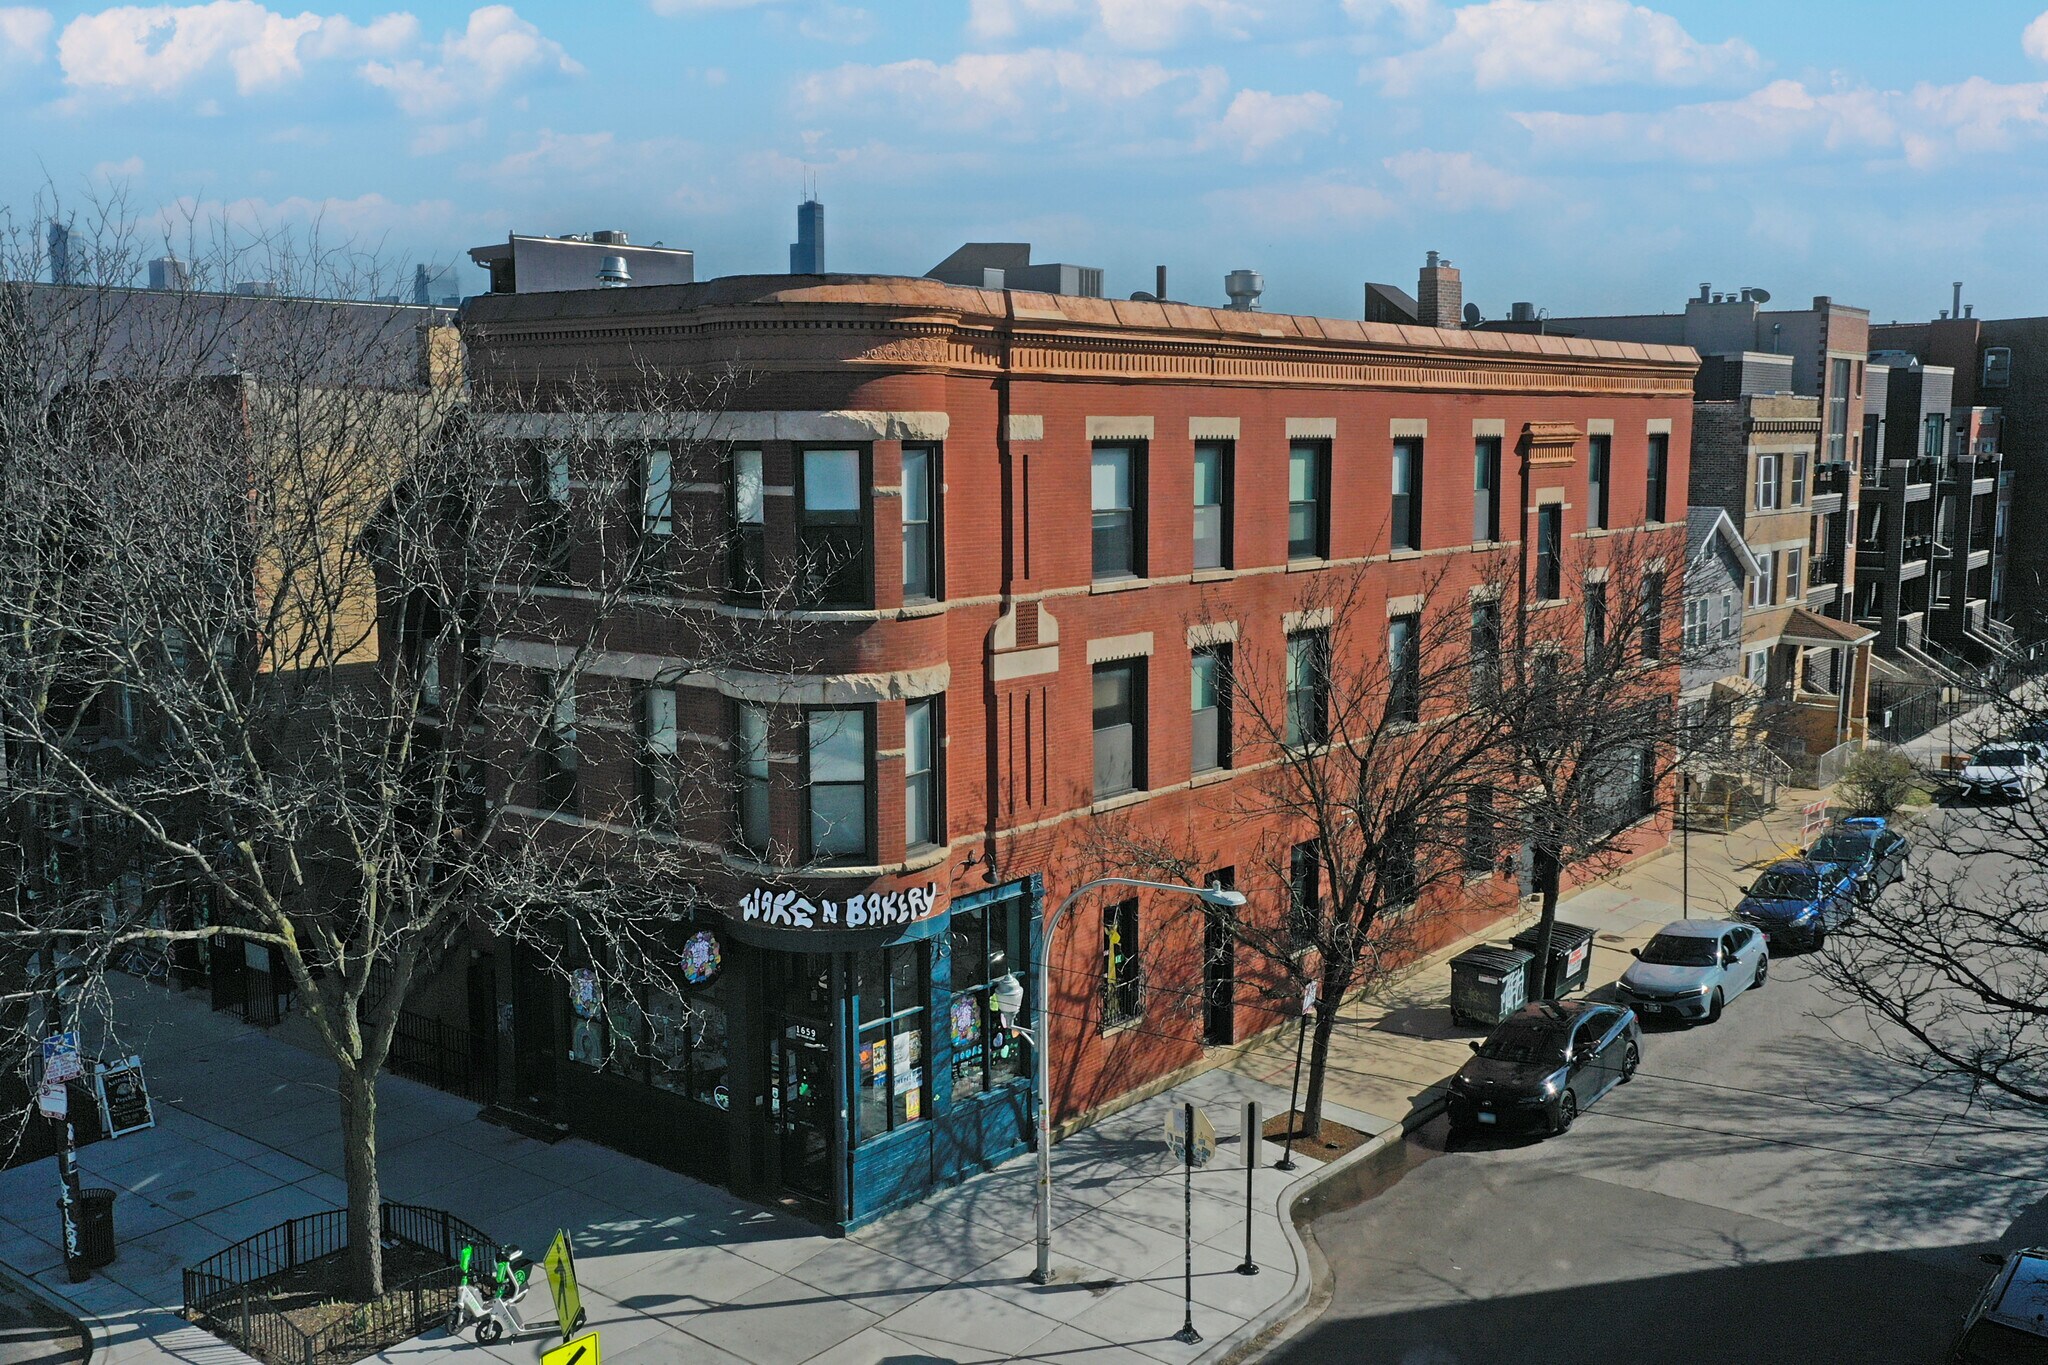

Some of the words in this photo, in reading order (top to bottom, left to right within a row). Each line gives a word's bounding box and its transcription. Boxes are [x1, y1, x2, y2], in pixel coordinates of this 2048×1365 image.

[738, 886, 817, 929] WAKE
[821, 899, 838, 924] N
[845, 881, 937, 929] BAKERY
[796, 1025, 816, 1037] 1659
